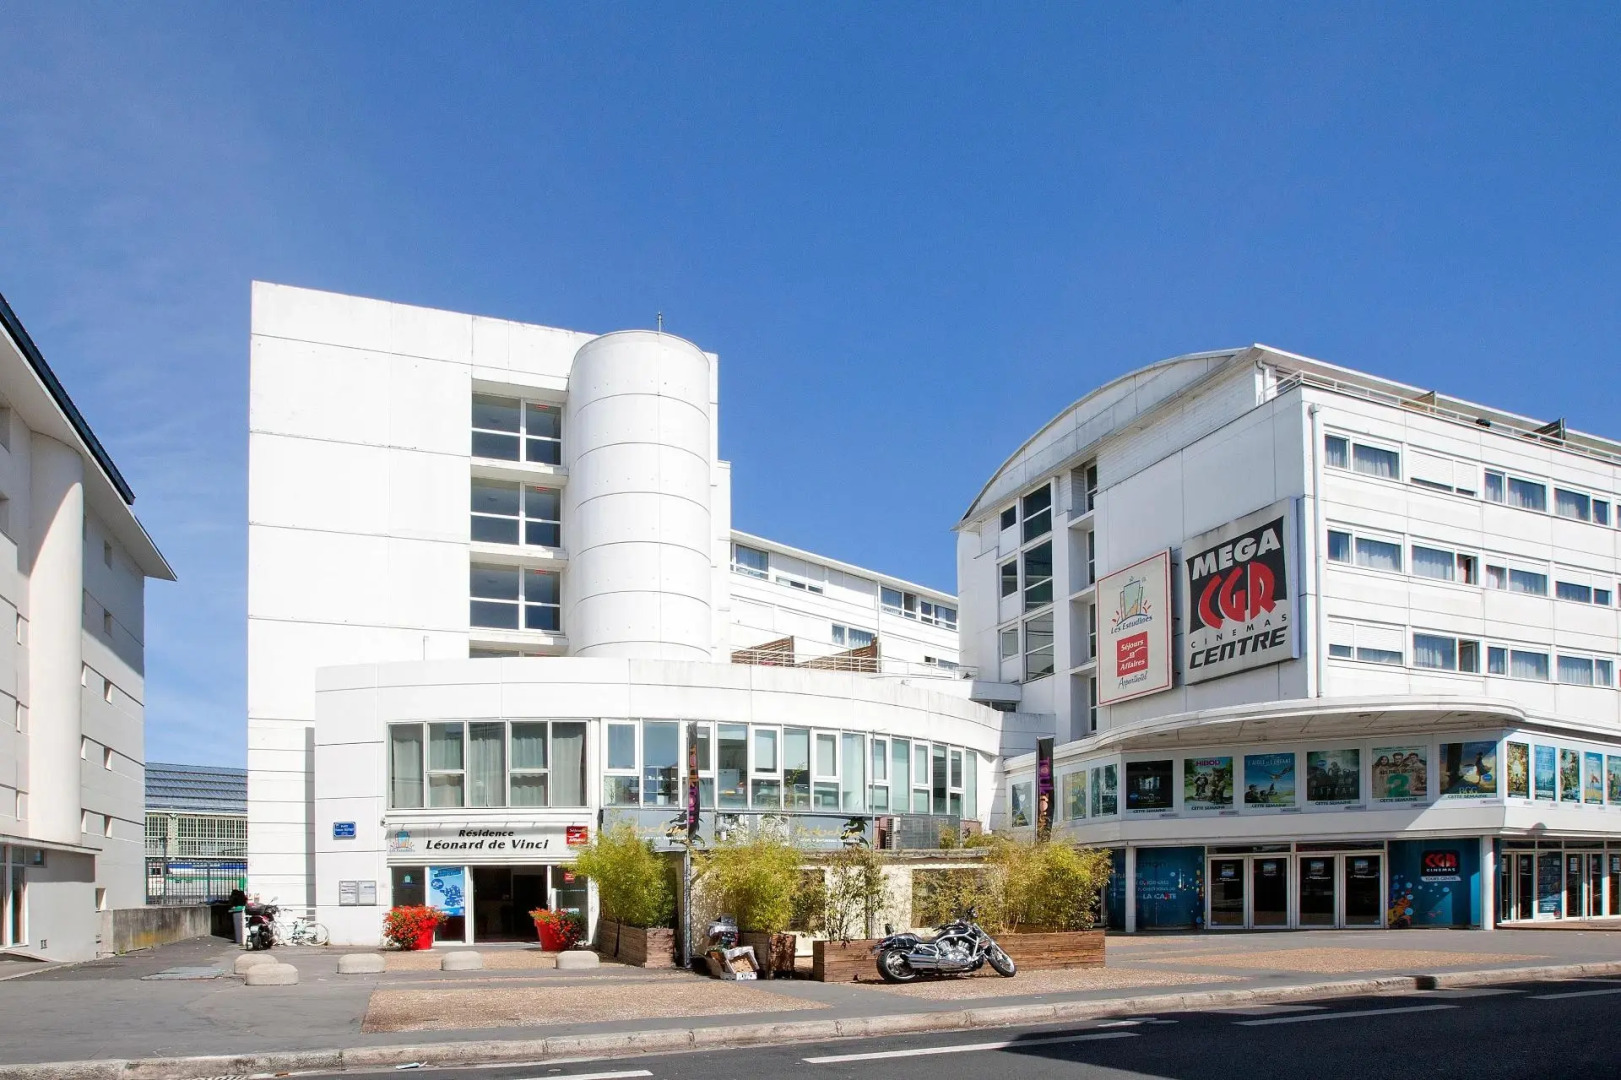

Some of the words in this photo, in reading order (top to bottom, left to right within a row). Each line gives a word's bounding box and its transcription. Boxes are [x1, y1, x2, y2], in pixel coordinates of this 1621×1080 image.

[1192, 528, 1281, 580] MEGA
[1198, 561, 1277, 629] CGR
[1123, 615, 1153, 631] Estudines
[1191, 613, 1287, 648] CINEMAS
[1120, 639, 1144, 652] Séjours
[1189, 626, 1288, 669] CENTRE
[1120, 659, 1145, 671] Affaires
[1386, 773, 1410, 798] 2
[458, 829, 514, 837] Résidence
[426, 839, 485, 850] Léonard
[488, 839, 506, 849] de
[511, 839, 549, 849] Vinci
[1425, 852, 1457, 868] CGR
